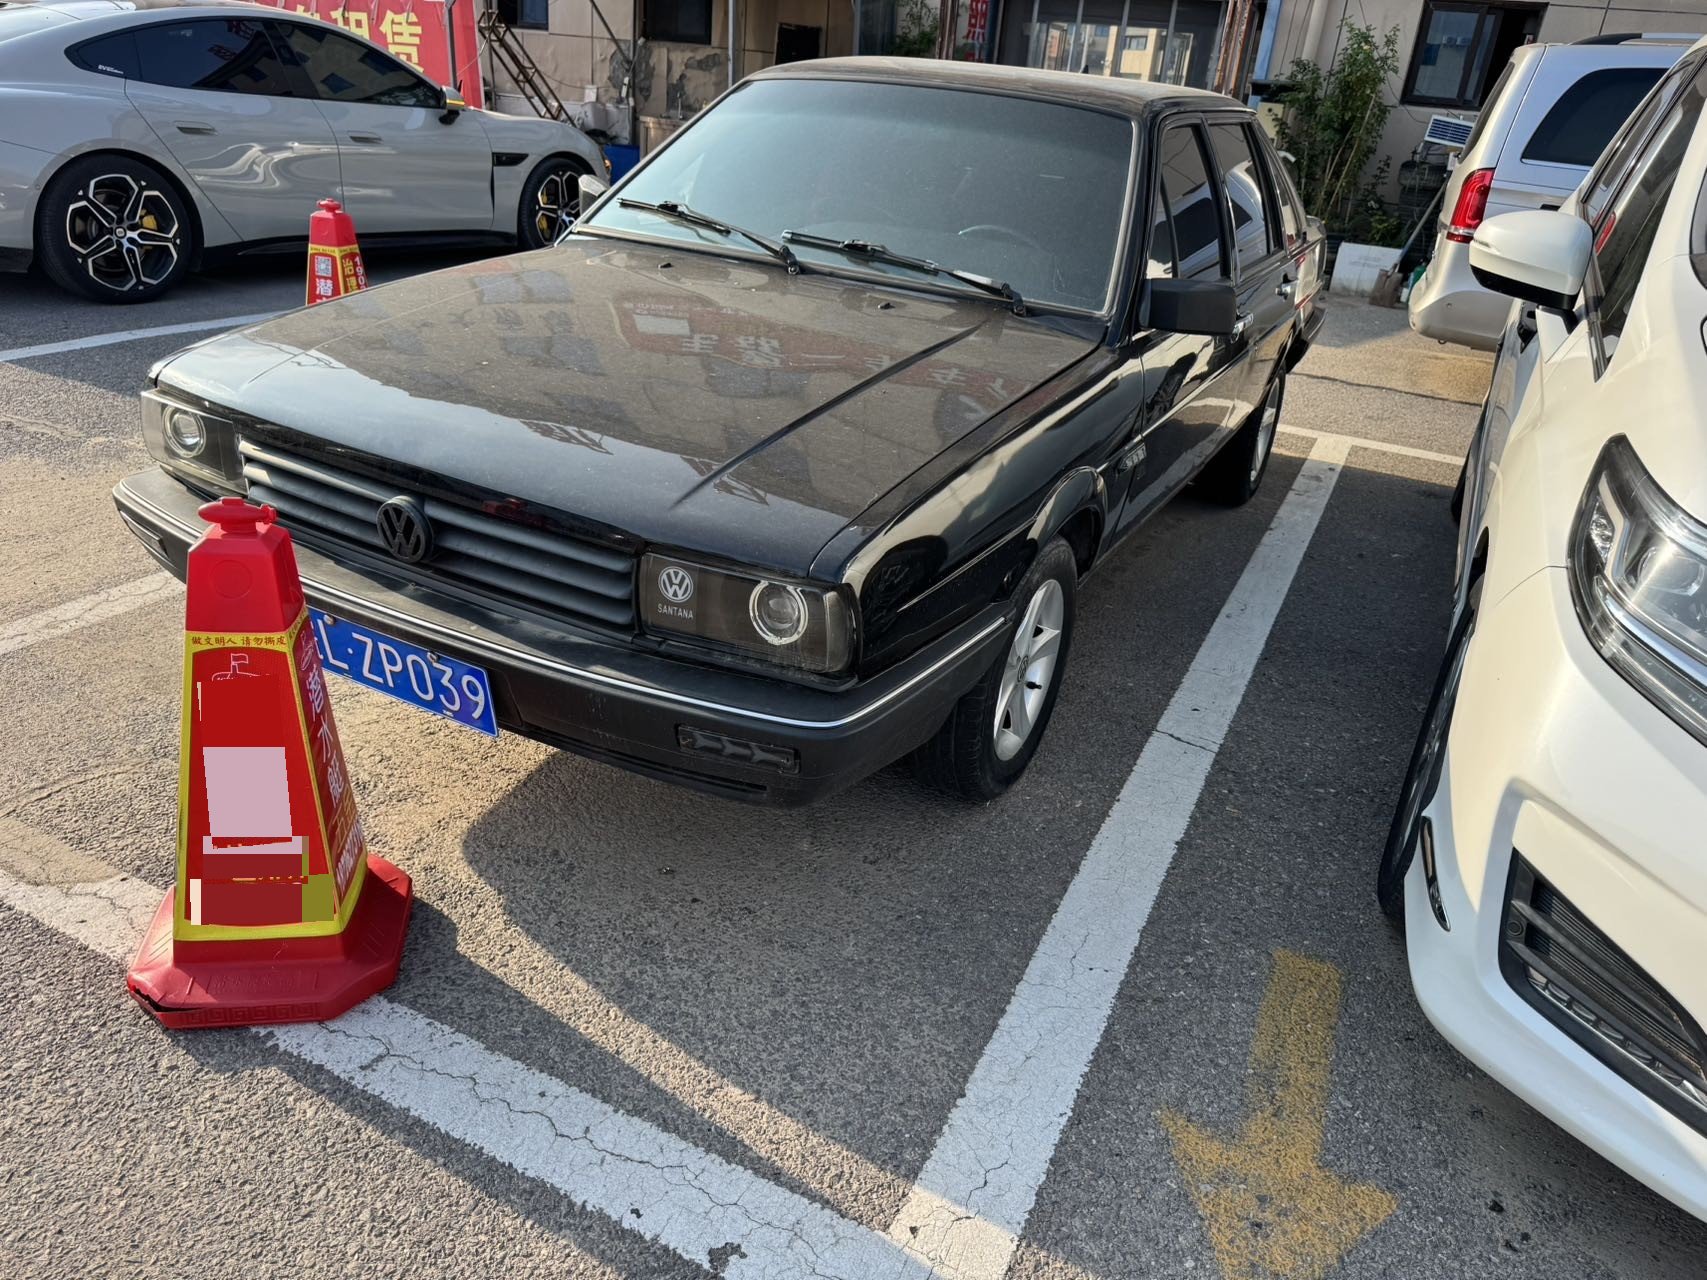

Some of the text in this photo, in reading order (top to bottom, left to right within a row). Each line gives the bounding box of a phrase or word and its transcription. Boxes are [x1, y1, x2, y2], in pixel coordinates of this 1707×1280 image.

[296, 5, 424, 73] 租赁
[657, 603, 694, 620] SANTANA
[310, 619, 486, 720] L·ZP039
[306, 663, 343, 808] 潜水艇
